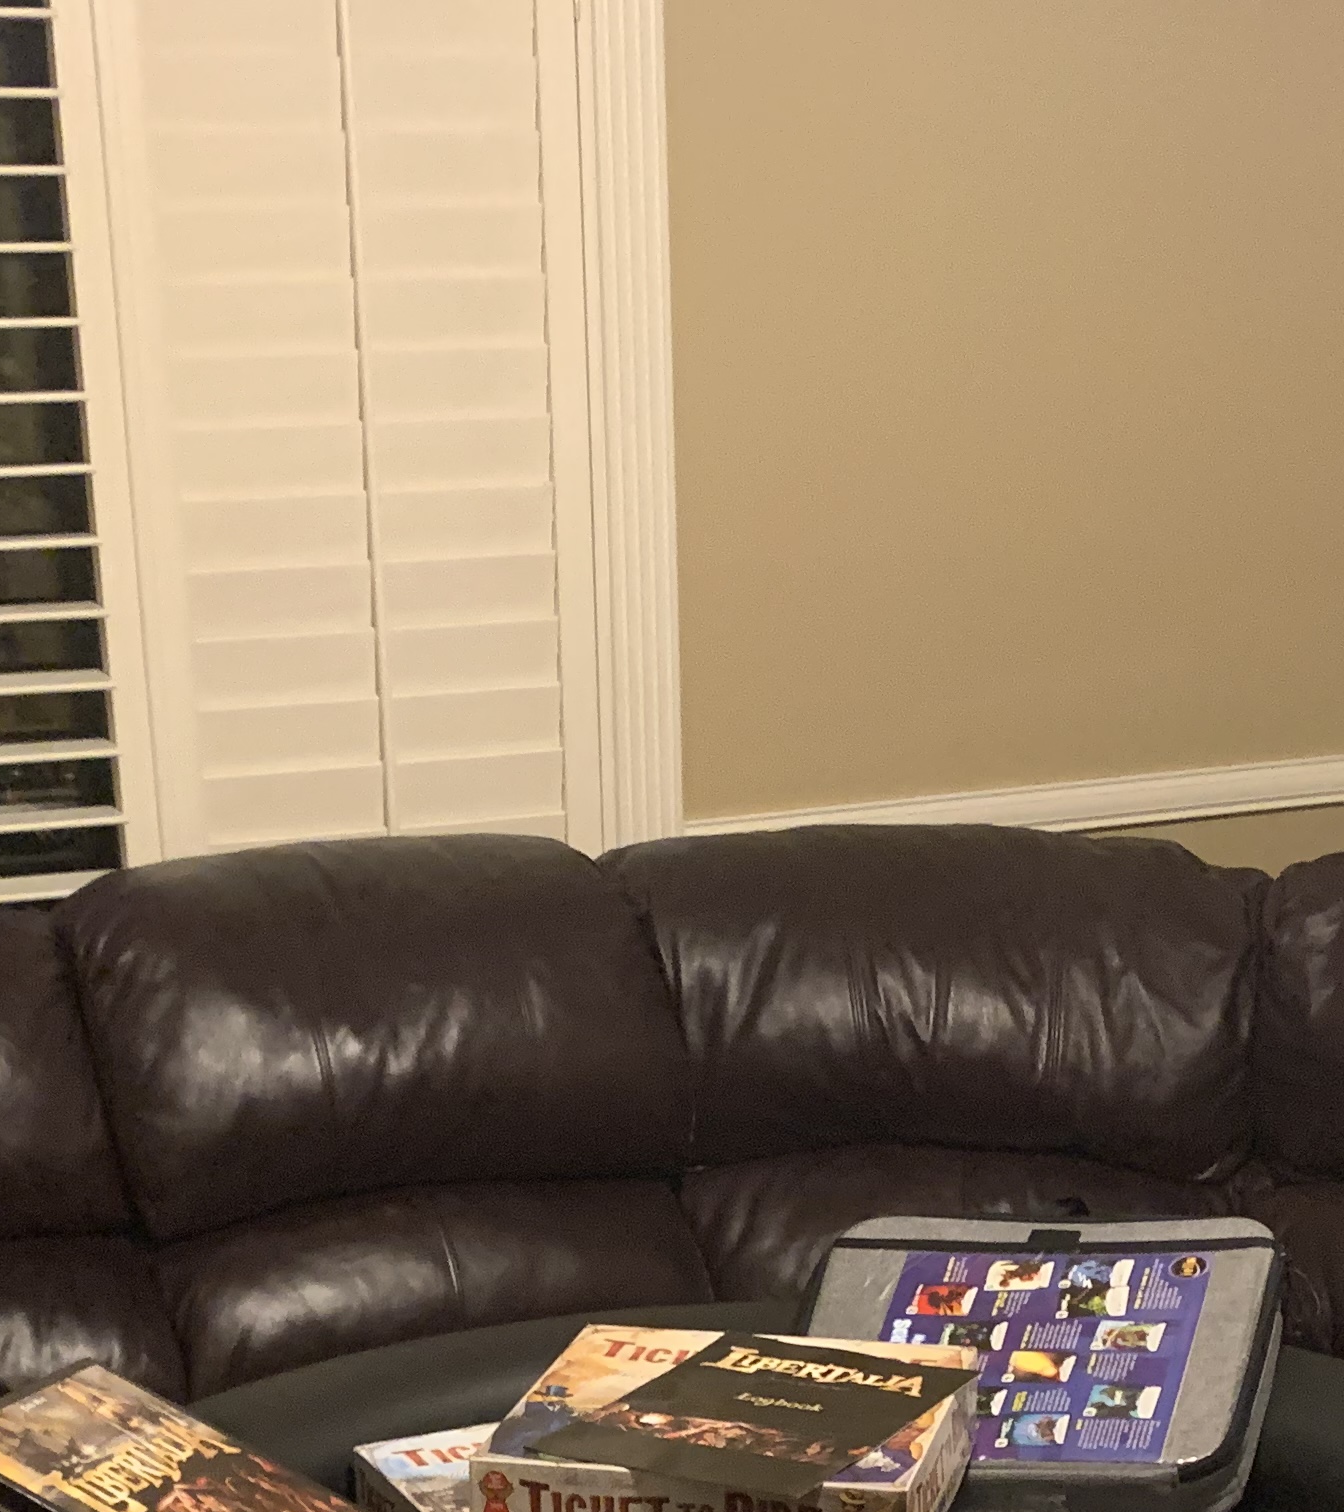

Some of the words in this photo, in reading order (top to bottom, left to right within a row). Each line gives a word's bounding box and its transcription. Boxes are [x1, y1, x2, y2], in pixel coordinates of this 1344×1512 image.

[604, 1339, 690, 1365] TIC
[700, 1346, 923, 1398] LIBERTALIA
[734, 1392, 824, 1412] Logbook
